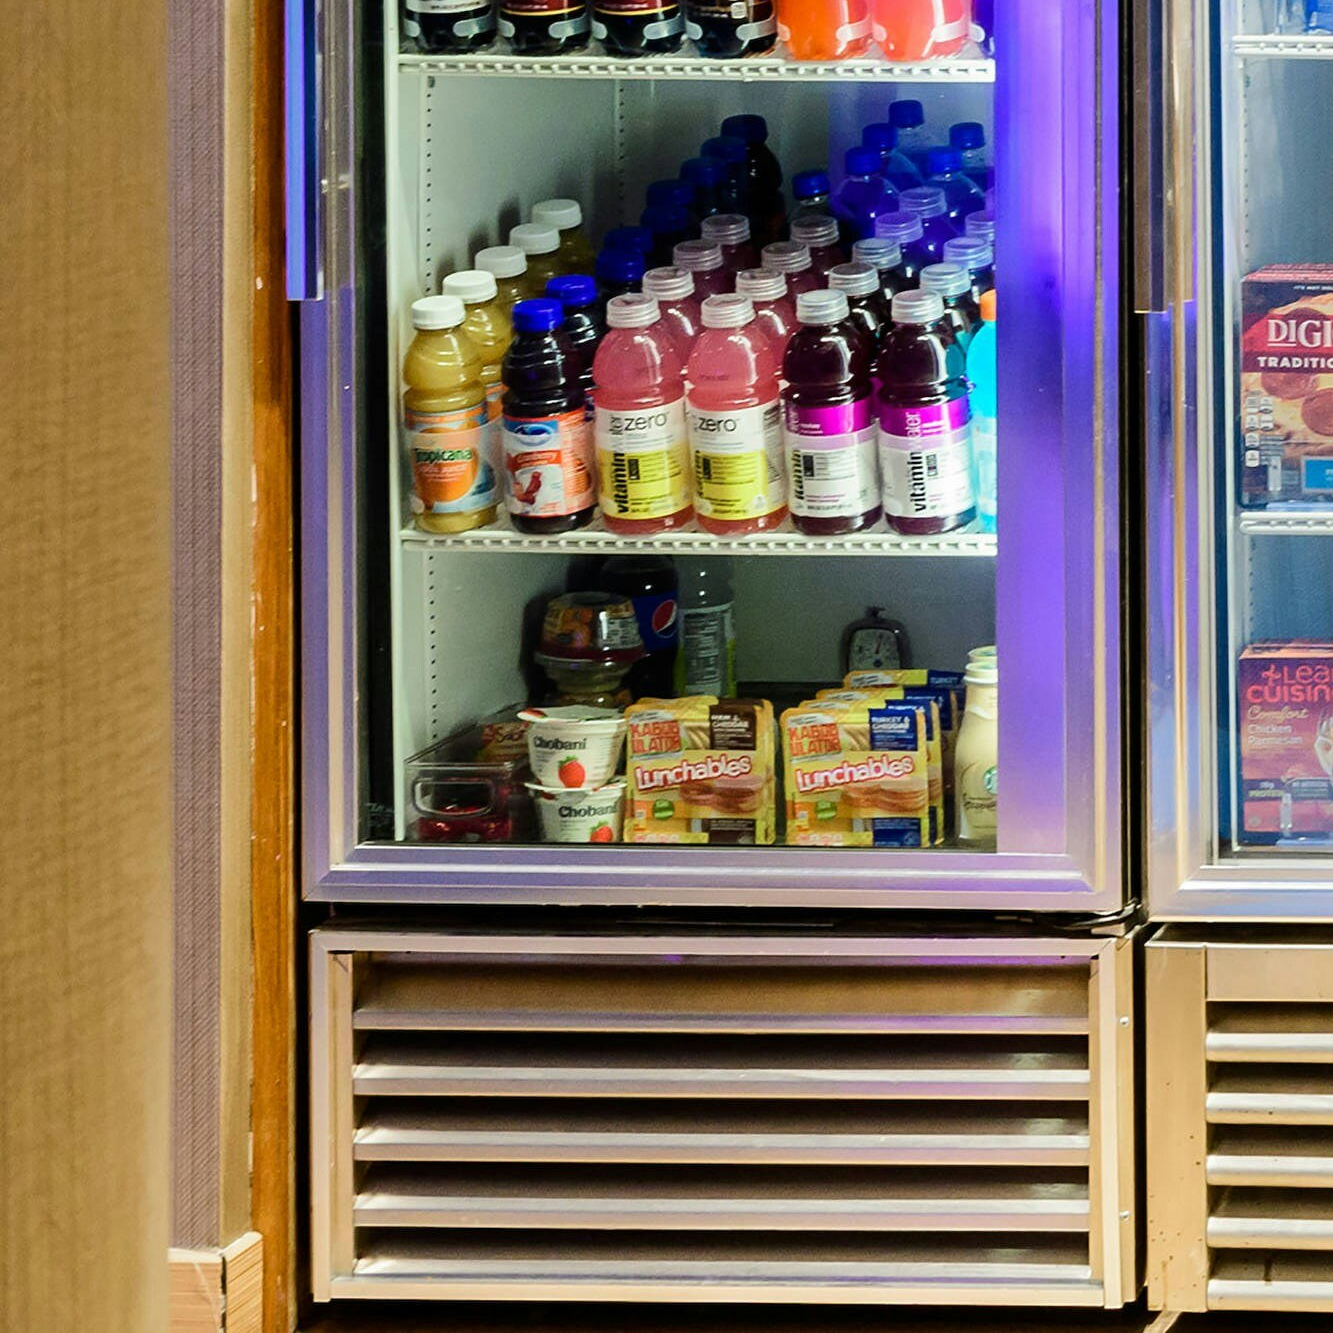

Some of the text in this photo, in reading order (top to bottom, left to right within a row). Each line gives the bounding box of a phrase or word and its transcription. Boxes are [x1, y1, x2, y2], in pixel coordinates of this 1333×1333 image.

[625, 414, 667, 432] zero
[698, 417, 736, 433] zero
[415, 449, 473, 463] Tropicana
[1248, 724, 1292, 734] Chicken
[533, 735, 587, 751] Chobani
[635, 755, 751, 791] Lunchables
[796, 755, 914, 793] Lunchables
[558, 804, 617, 819] Chobani
